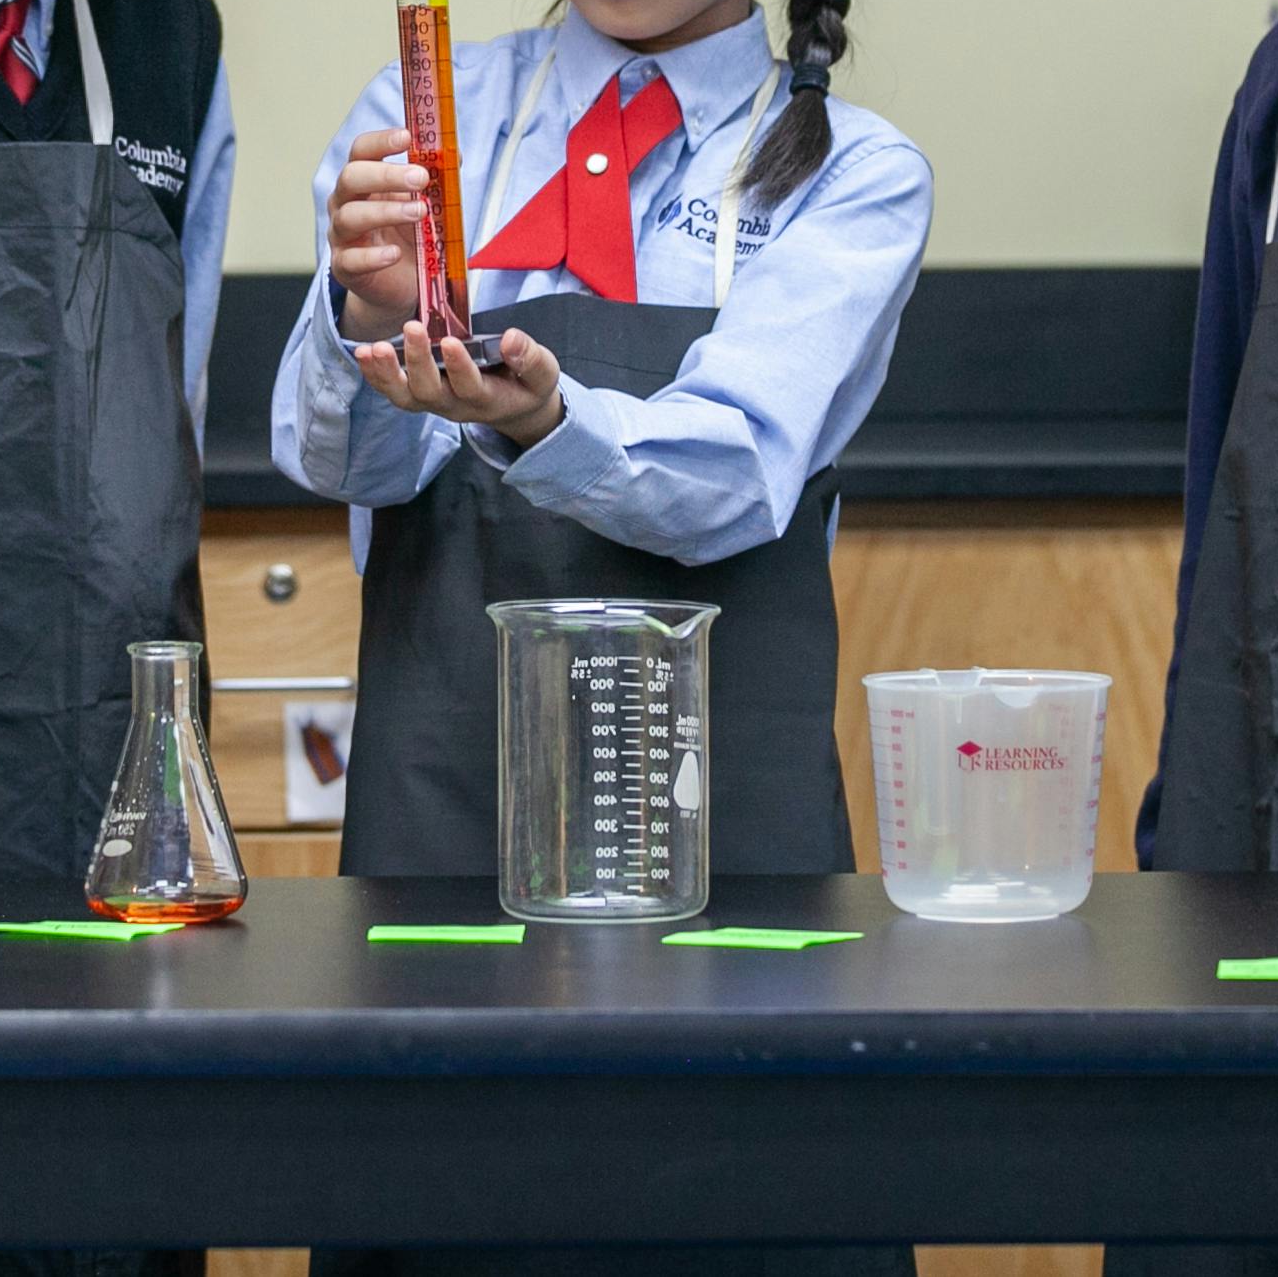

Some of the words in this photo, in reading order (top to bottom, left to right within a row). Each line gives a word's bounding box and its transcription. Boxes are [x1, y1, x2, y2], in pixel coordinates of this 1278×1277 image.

[408, 3, 427, 17] 95
[410, 22, 428, 35] 90
[410, 40, 430, 53] 85
[411, 58, 431, 71] 80
[413, 76, 432, 90] 75
[414, 94, 434, 107] 70
[416, 112, 435, 125] 65
[417, 131, 436, 143] 60
[419, 149, 438, 162] 55
[429, 167, 439, 180] 0
[129, 165, 184, 198] ademy
[426, 203, 442, 216] 0
[425, 222, 443, 235] 35
[426, 240, 444, 253] 30
[427, 258, 447, 272] 25
[985, 747, 1059, 759] LEARNING
[985, 759, 1064, 771] RESOURCES
